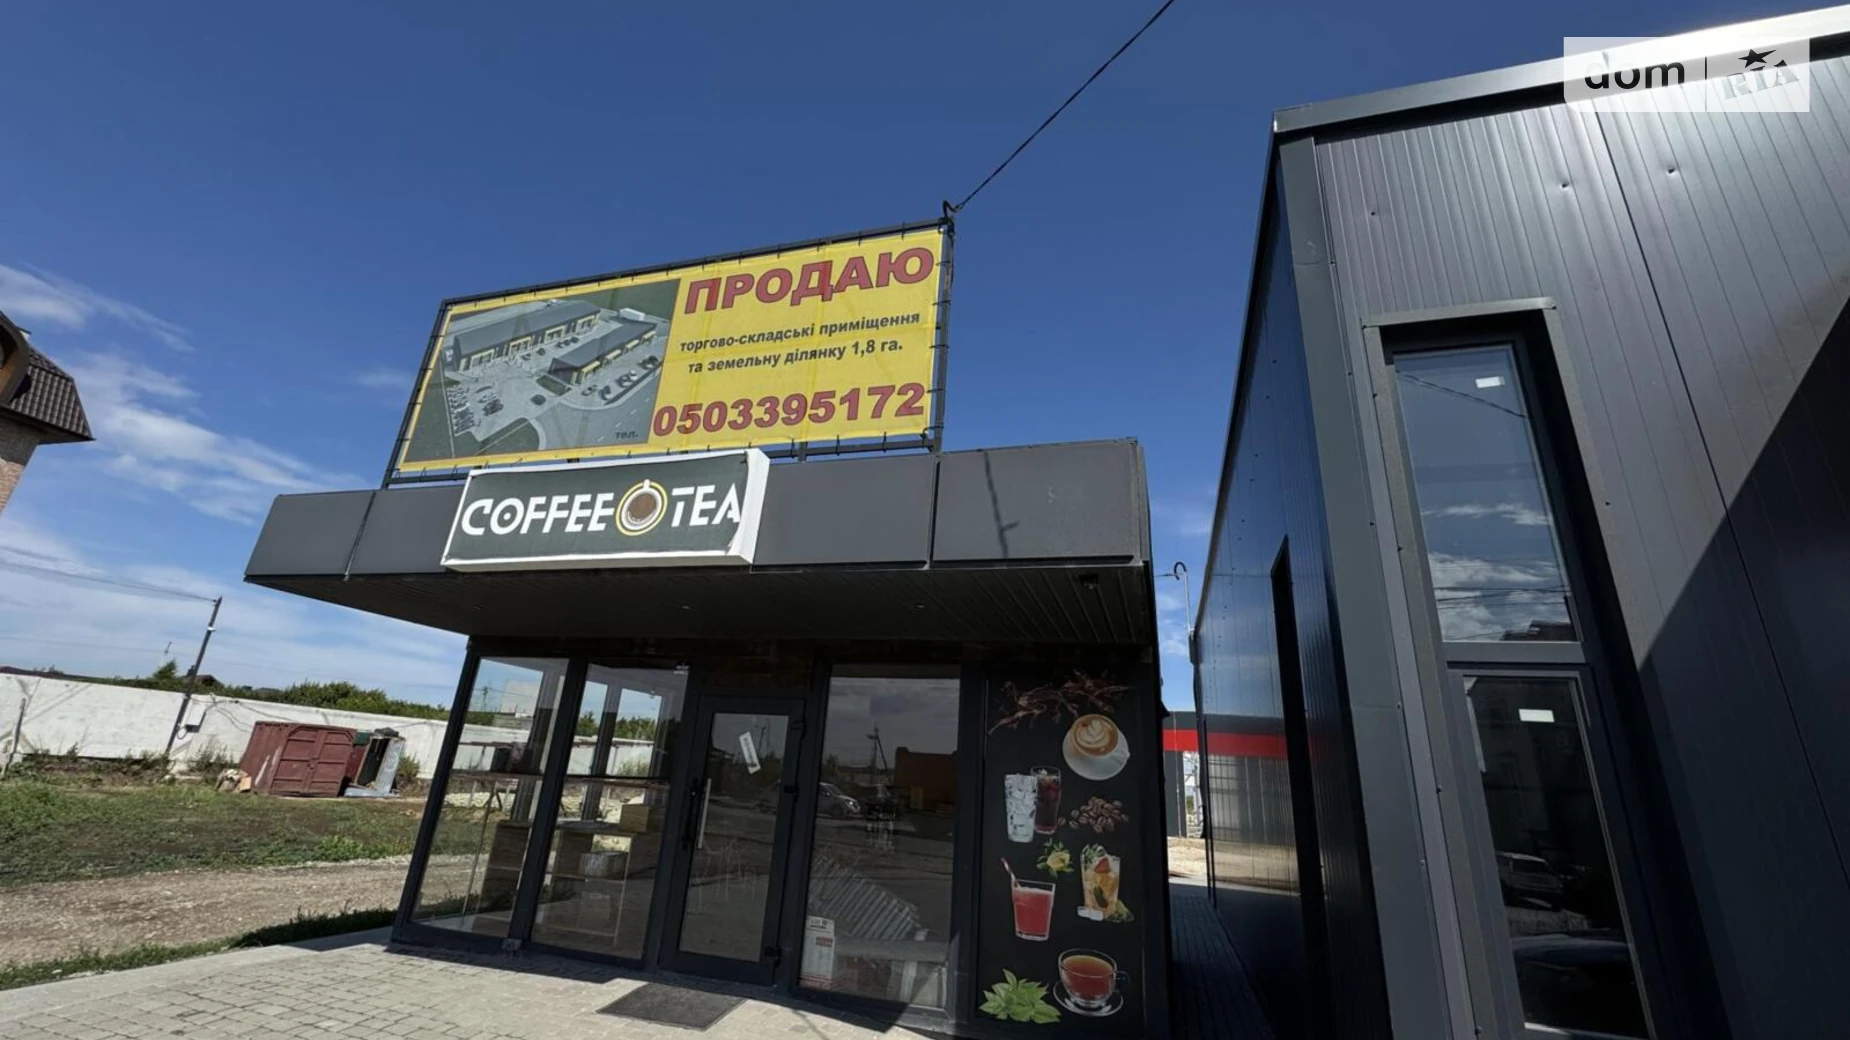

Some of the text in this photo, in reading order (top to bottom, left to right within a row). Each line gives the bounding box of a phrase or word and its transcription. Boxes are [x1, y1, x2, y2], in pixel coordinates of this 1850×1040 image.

[684, 247, 934, 315] ПРОДАЮ
[680, 313, 920, 353] торгово-складські приміщення
[688, 339, 903, 374] та земельну ділянку 1,8 га.
[652, 382, 926, 437] 0503395172
[460, 482, 742, 536] COFFEE TEA
